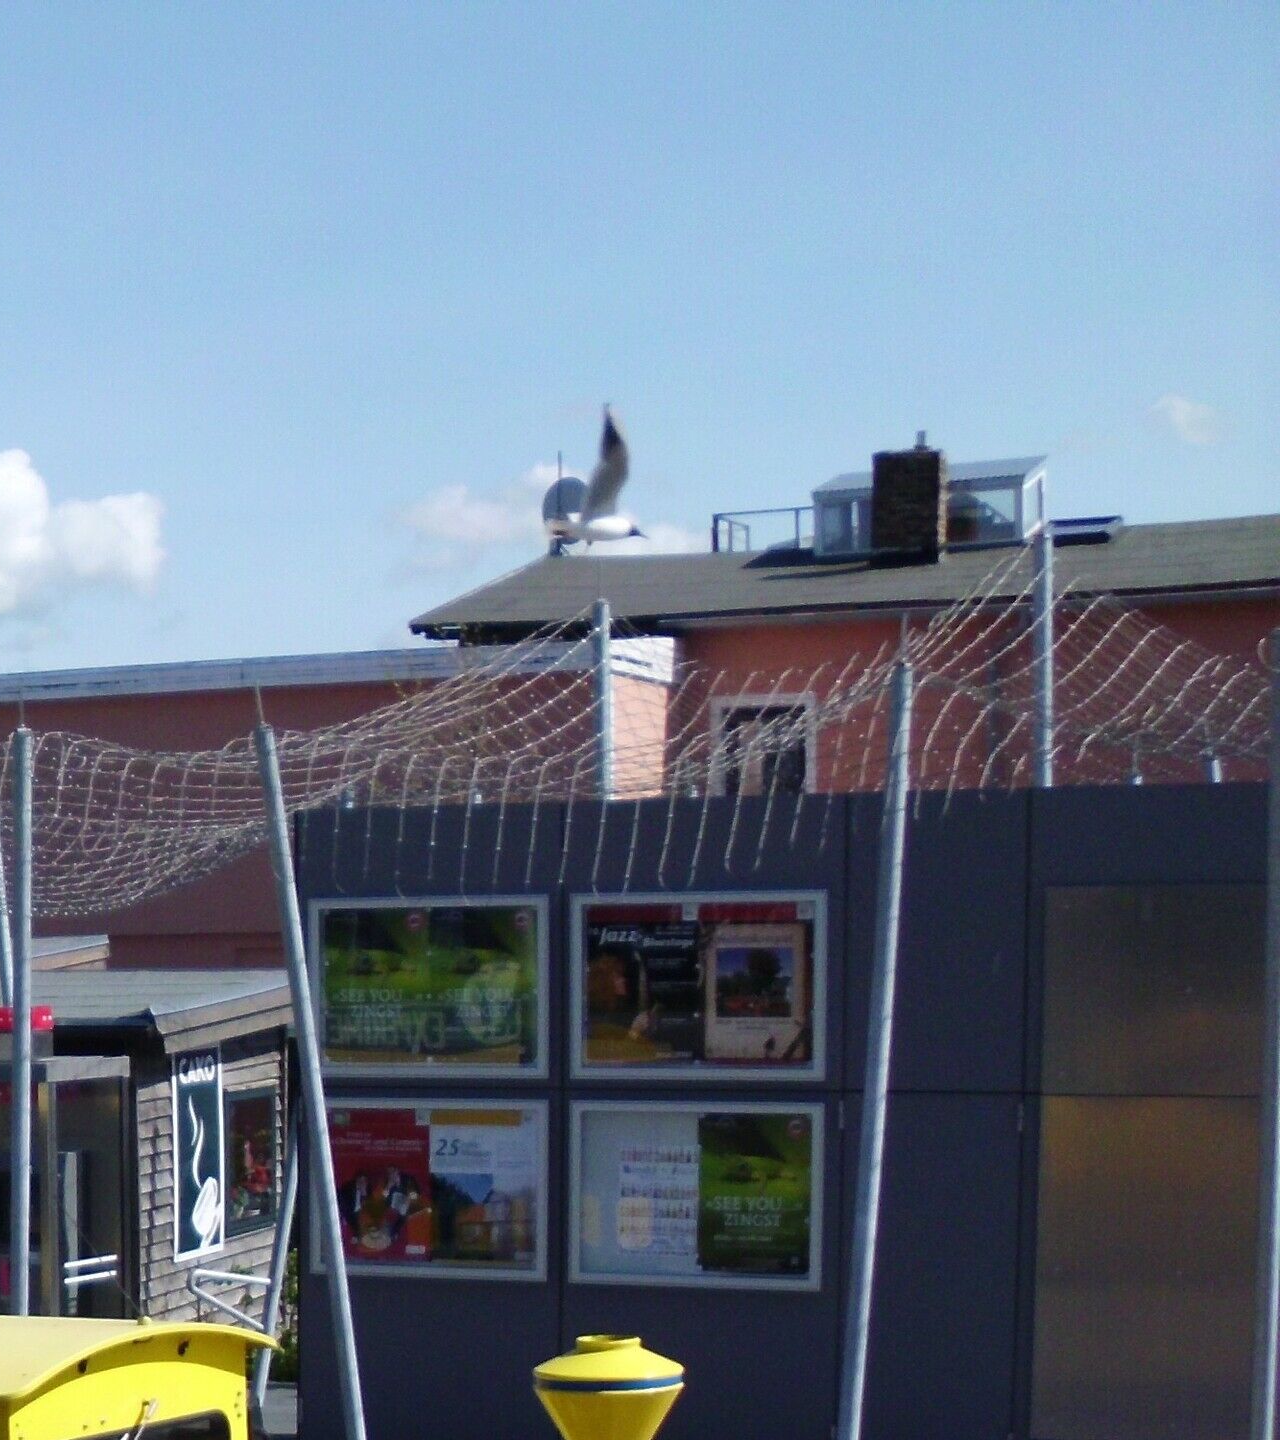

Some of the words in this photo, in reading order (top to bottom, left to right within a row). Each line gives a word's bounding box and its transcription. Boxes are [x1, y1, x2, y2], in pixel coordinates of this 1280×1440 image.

[435, 1138, 461, 1156] 25
[745, 1197, 783, 1211] YOU
[725, 1213, 781, 1227] ZINGST
